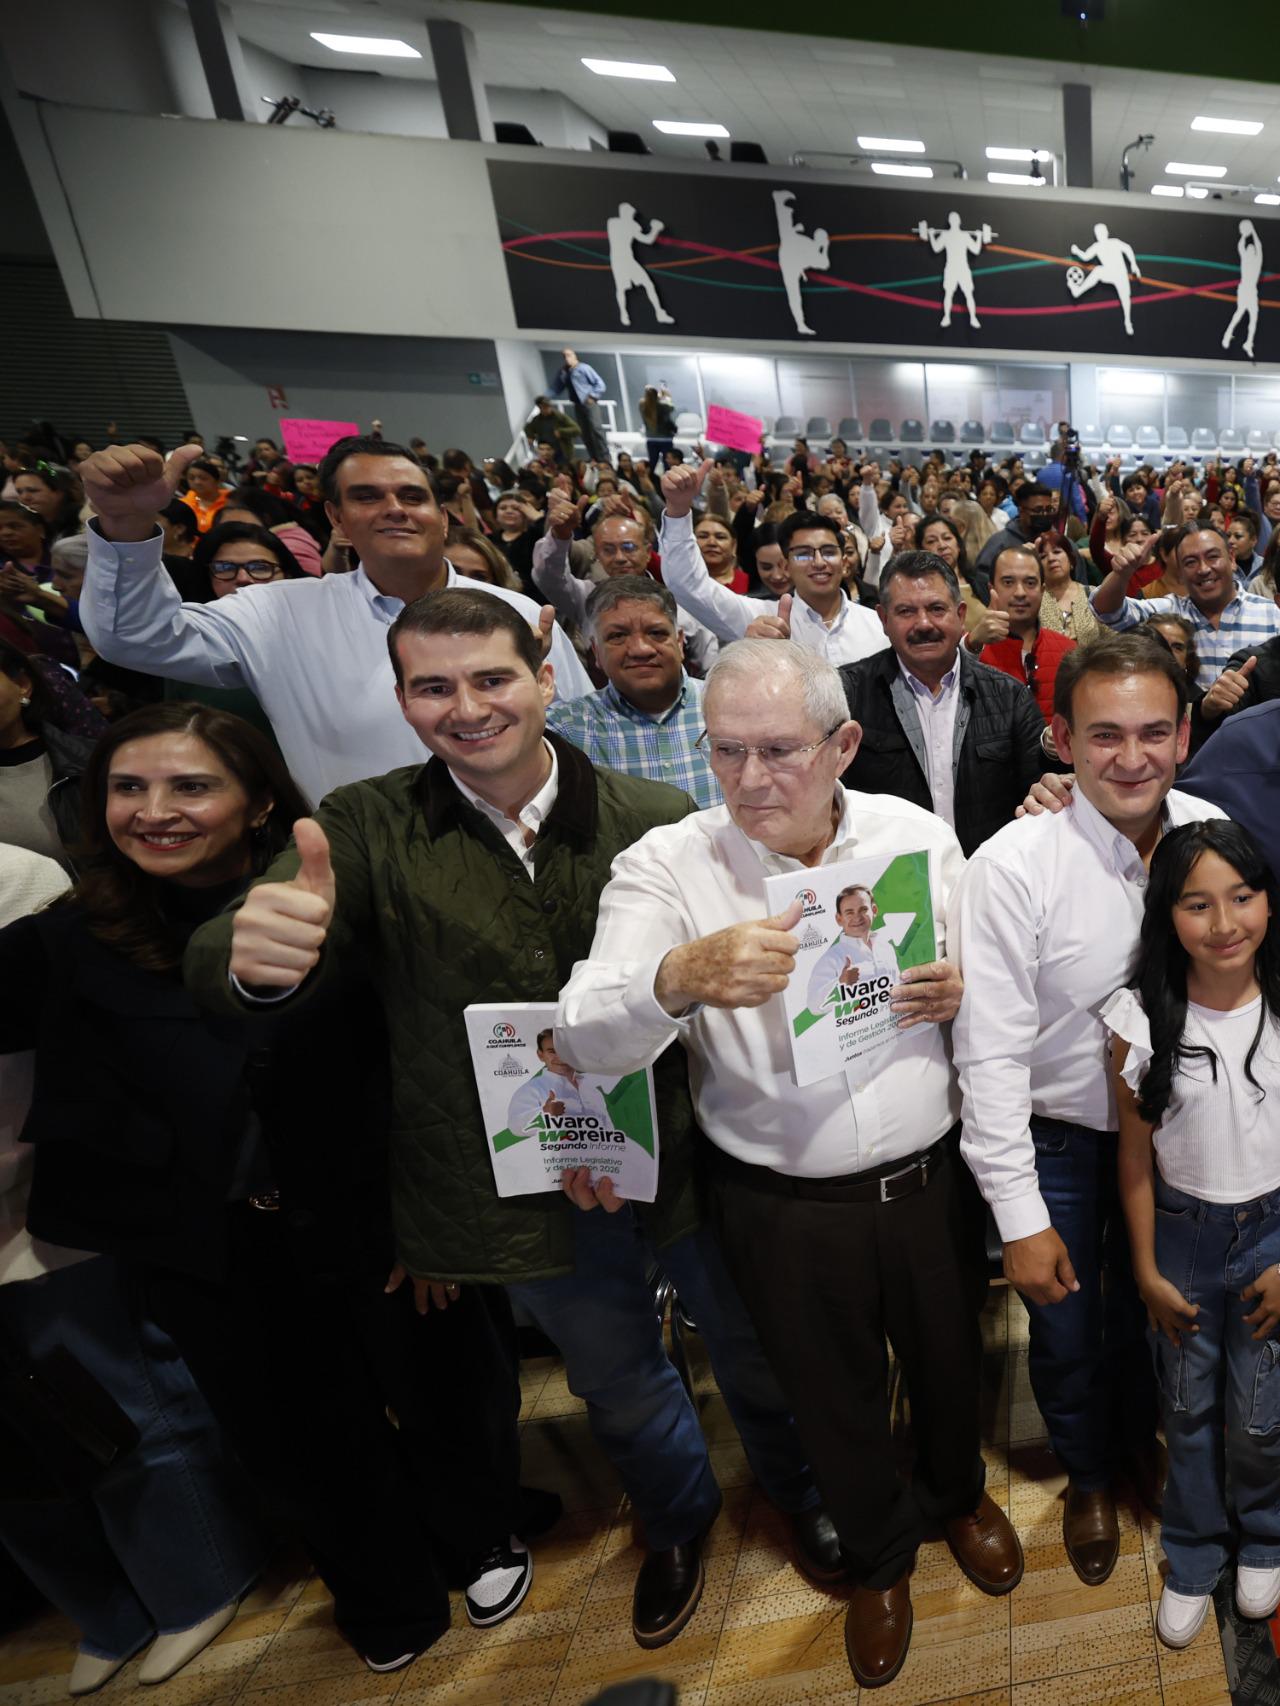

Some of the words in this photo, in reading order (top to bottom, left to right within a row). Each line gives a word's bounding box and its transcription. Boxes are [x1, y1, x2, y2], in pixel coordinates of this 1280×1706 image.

[800, 937, 829, 950] OAHUILA
[834, 984, 893, 1018] More
[836, 1007, 879, 1027] Segundo
[838, 1026, 869, 1041] Informe
[839, 1043, 845, 1051] y
[846, 1039, 857, 1048] de
[858, 1026, 886, 1043] Gestión
[540, 1142, 588, 1151] Segundo
[589, 1142, 627, 1152] Informe
[543, 1157, 578, 1165] Informe
[580, 1156, 623, 1166] Legislativo
[600, 1165, 620, 1174] 2026
